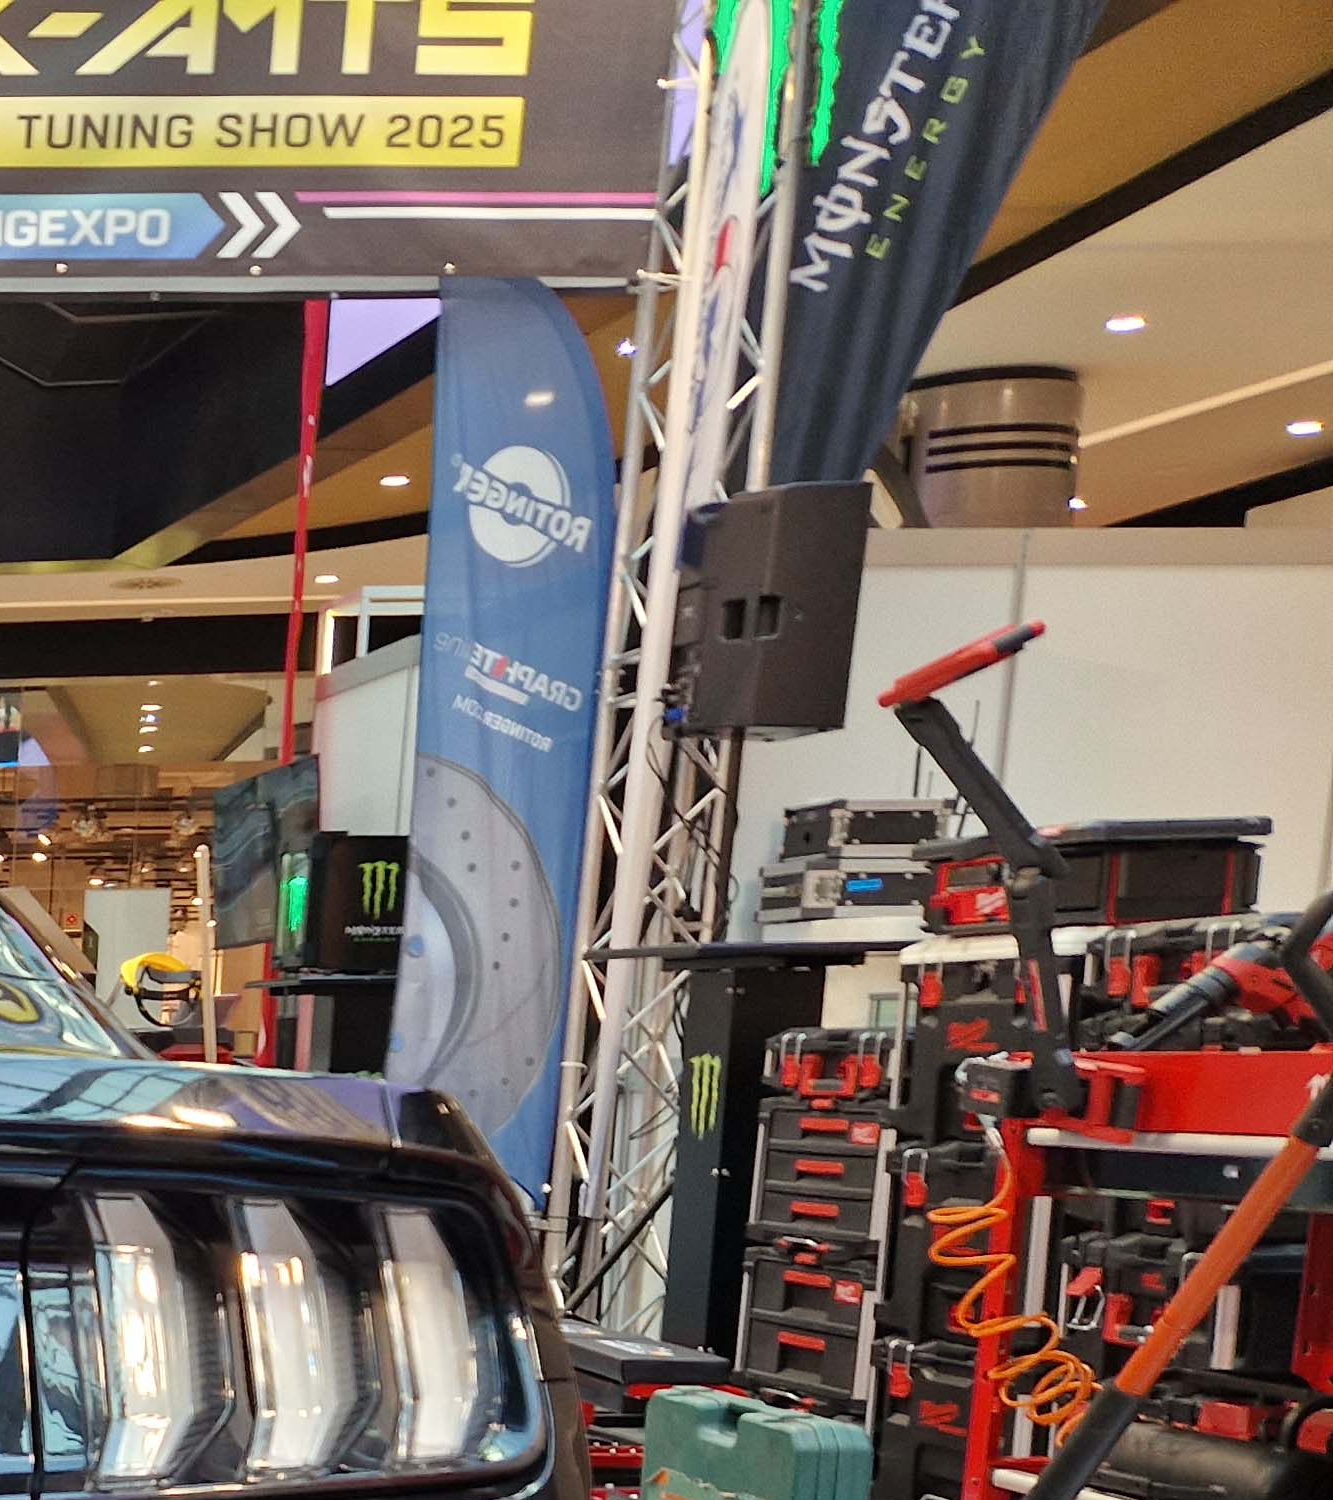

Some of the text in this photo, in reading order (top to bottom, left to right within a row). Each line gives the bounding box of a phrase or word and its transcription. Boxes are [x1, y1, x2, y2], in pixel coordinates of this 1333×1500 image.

[18, 113, 194, 150] TUNING
[215, 113, 366, 149] SHOW
[385, 113, 506, 149] 2025
[865, 35, 985, 260] ENERGY
